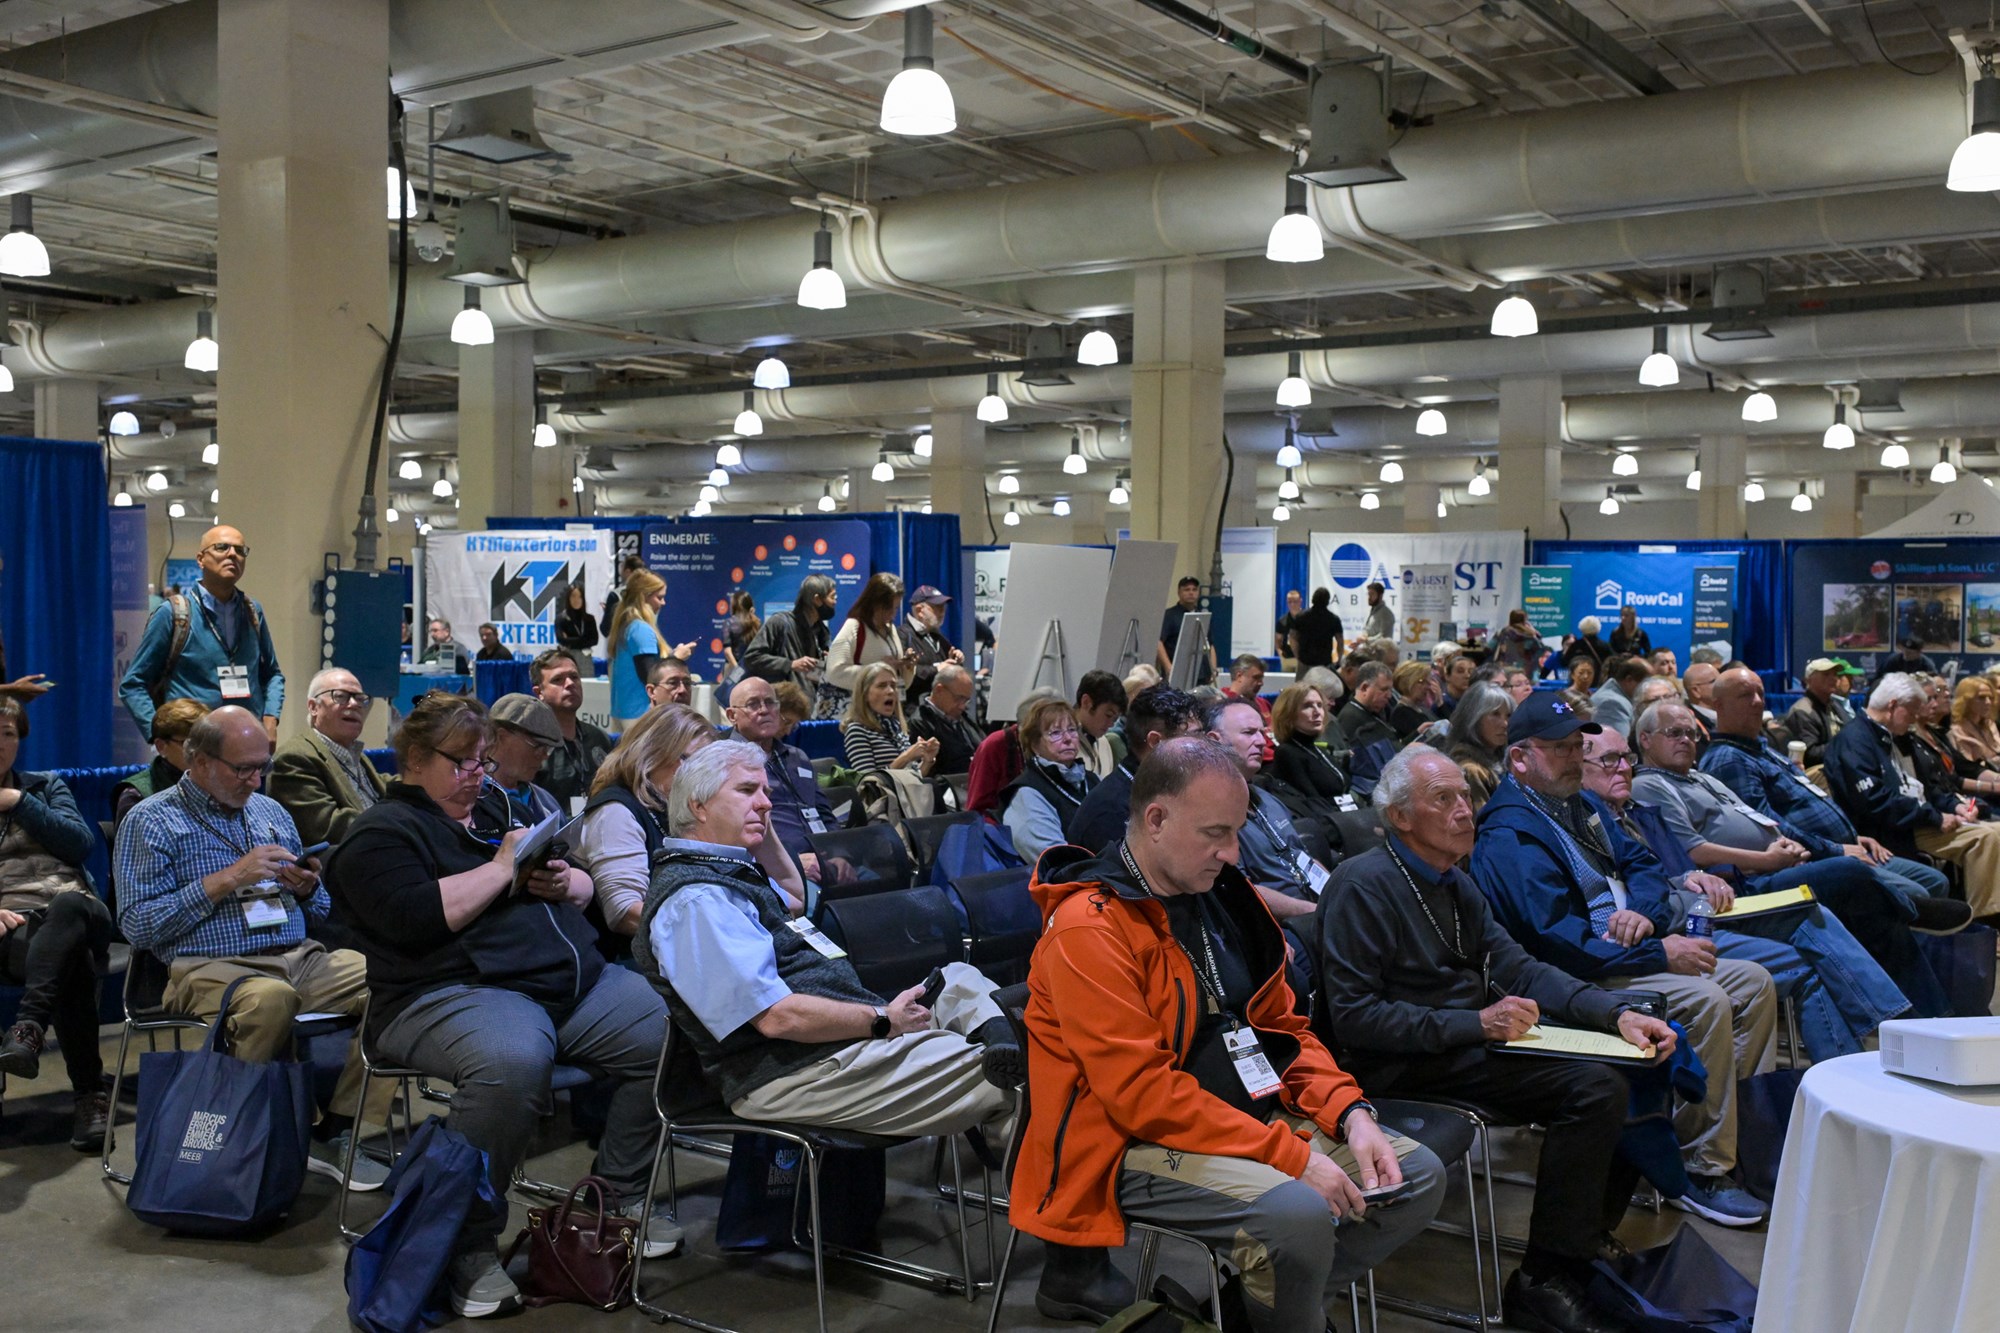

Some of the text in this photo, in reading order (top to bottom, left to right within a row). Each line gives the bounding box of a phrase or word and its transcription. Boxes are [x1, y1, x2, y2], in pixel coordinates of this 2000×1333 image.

[649, 533, 711, 545] ENUMERATE
[650, 563, 689, 571] communities
[1975, 563, 1996, 573] LLC
[1372, 561, 1503, 591] A-ST
[1330, 594, 1501, 607] ABTENT
[1625, 591, 1684, 607] RowCal
[1124, 851, 1143, 880] PROPERTY
[1205, 947, 1218, 975] PROPERTY
[1214, 975, 1226, 997] KELLY'S
[192, 1110, 227, 1125] MARCUS
[189, 1120, 218, 1133] ERRICO
[186, 1129, 223, 1143] EMMER &
[182, 1137, 215, 1150] BROOKS
[179, 1150, 202, 1161] MEEB
